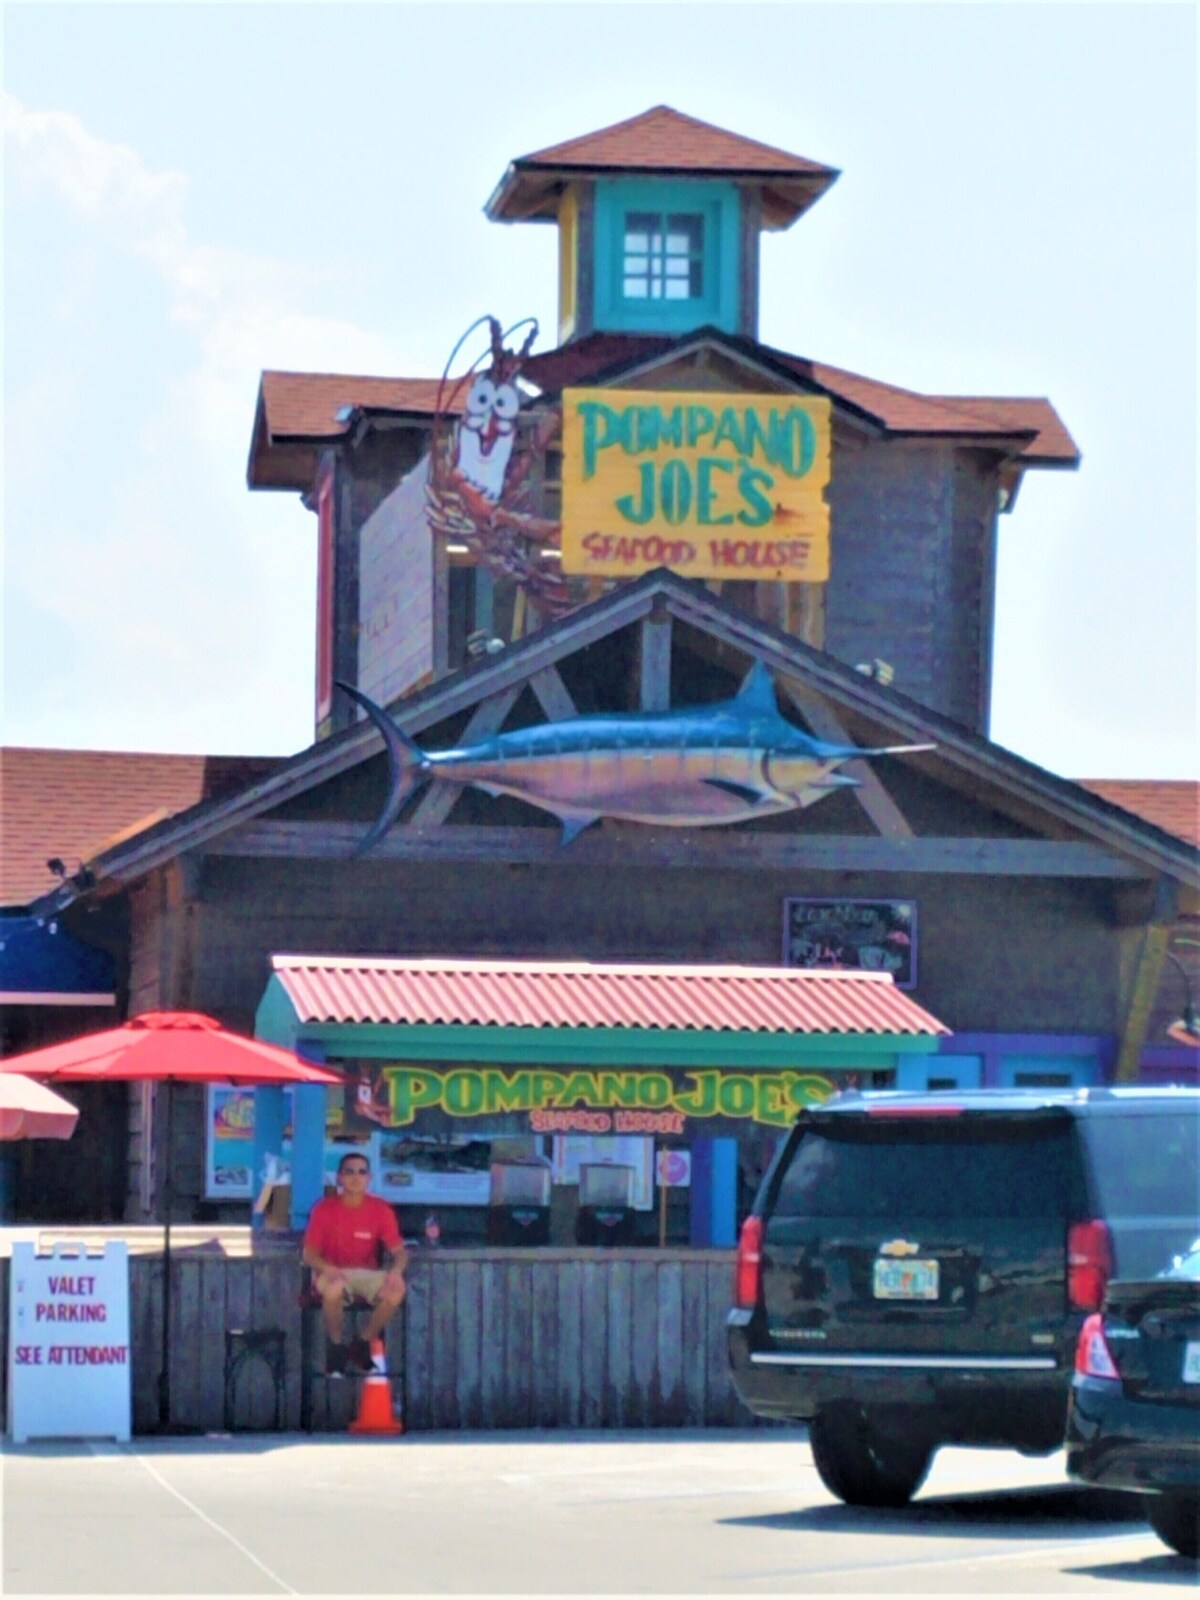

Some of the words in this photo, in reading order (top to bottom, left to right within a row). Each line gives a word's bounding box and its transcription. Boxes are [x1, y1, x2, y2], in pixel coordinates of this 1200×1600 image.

[577, 400, 816, 479] POMPANO
[615, 456, 775, 527] JOE'S
[582, 532, 697, 565] SEAFOOD
[709, 538, 811, 568] HOUSE
[382, 1067, 673, 1127] POMPANO
[48, 1276, 96, 1295] VALET
[35, 1303, 107, 1322] PARKING
[14, 1346, 43, 1365] SEE
[47, 1346, 128, 1365] ATTENDANT
